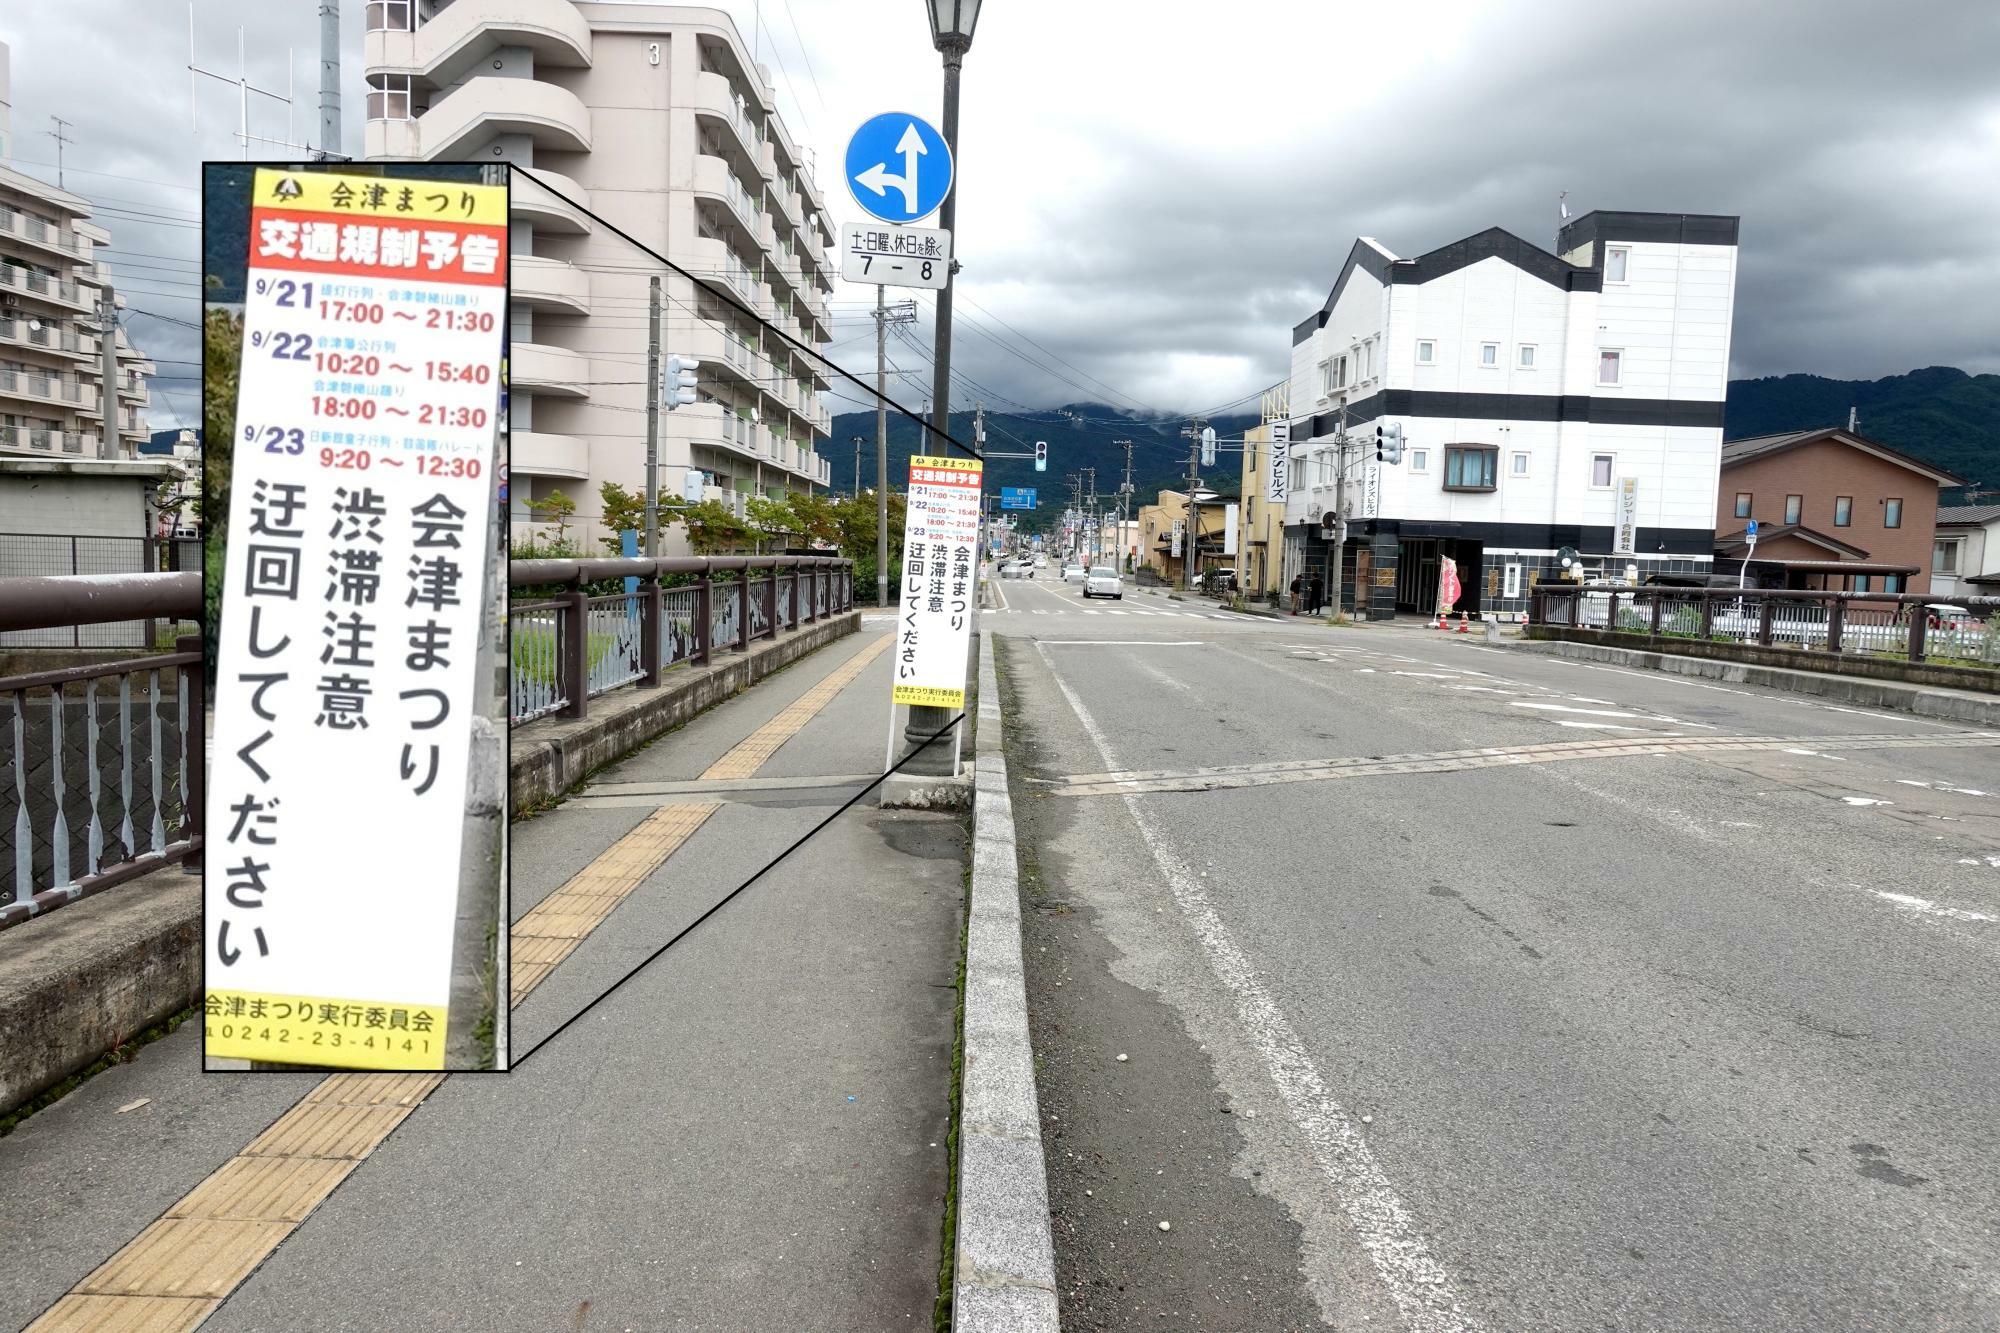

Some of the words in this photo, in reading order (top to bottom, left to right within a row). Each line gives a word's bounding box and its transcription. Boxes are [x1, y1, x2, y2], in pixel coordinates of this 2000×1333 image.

[650, 43, 660, 66] 3
[330, 181, 477, 217] 会津まつり
[258, 219, 500, 273] 交通規制予告
[256, 277, 313, 309] 9/21
[320, 300, 383, 325] 17:00
[426, 308, 494, 333] 21:30
[251, 331, 313, 361] 9/22
[315, 352, 380, 376] 10:20
[425, 361, 490, 384] 15:40
[311, 396, 376, 420] 18:00
[418, 404, 486, 428] 21:30
[244, 425, 305, 455] 9/23
[320, 447, 370, 470] 9:20
[416, 455, 481, 479] 12:30
[932, 459, 973, 468] 会津まつり
[927, 544, 948, 613] 渋滞注意
[951, 545, 970, 631] 会津まつり
[314, 487, 387, 731] 渋滞注意
[900, 542, 926, 679] 迂回してください
[399, 493, 467, 796] 会津まつり
[218, 478, 307, 966] 迂回してください
[205, 994, 434, 1032] 会津まつり実行委員会
